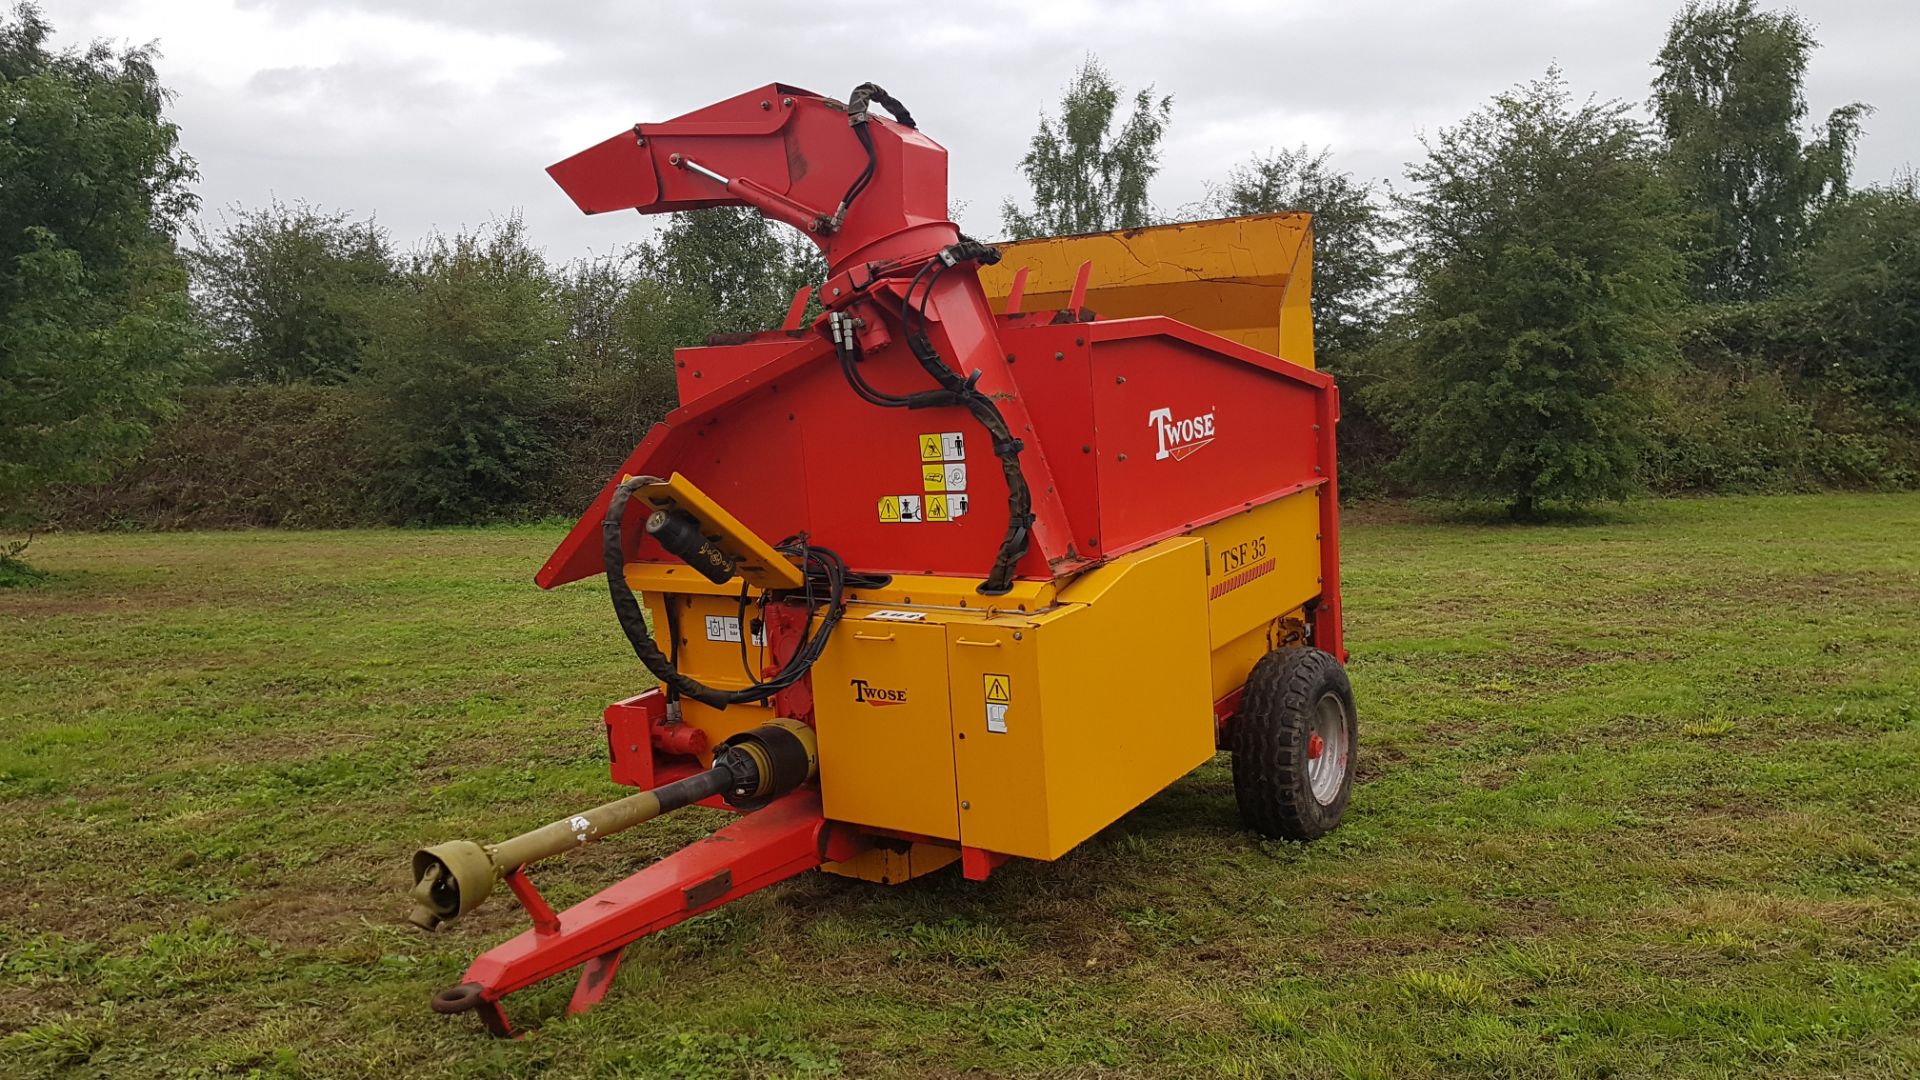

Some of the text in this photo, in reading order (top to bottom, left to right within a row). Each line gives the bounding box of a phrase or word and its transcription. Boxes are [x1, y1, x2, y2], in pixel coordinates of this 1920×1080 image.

[1148, 407, 1216, 461] TWOSE
[1220, 536, 1266, 573] TSF 35
[850, 679, 907, 702] TWOSE
